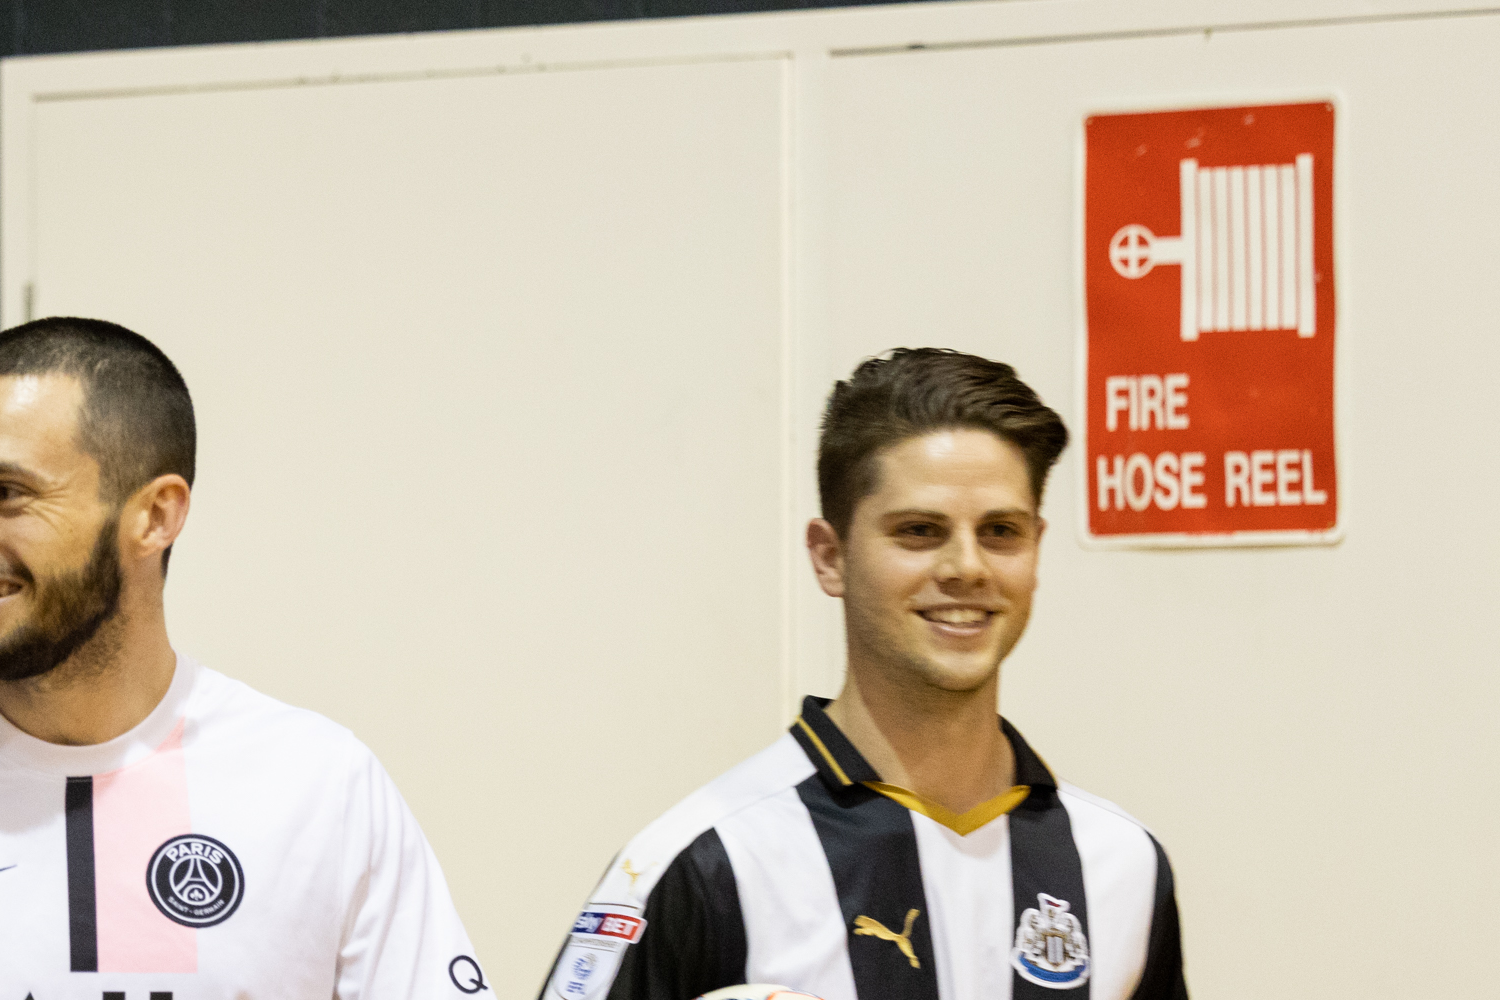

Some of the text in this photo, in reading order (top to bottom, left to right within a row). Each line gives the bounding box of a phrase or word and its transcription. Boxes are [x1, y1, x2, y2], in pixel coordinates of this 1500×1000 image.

[1104, 373, 1190, 432] FIRE
[1097, 449, 1328, 512] HOSE REEL
[165, 842, 224, 864] PARIS
[601, 916, 639, 937] BET
[448, 954, 489, 995] Q
